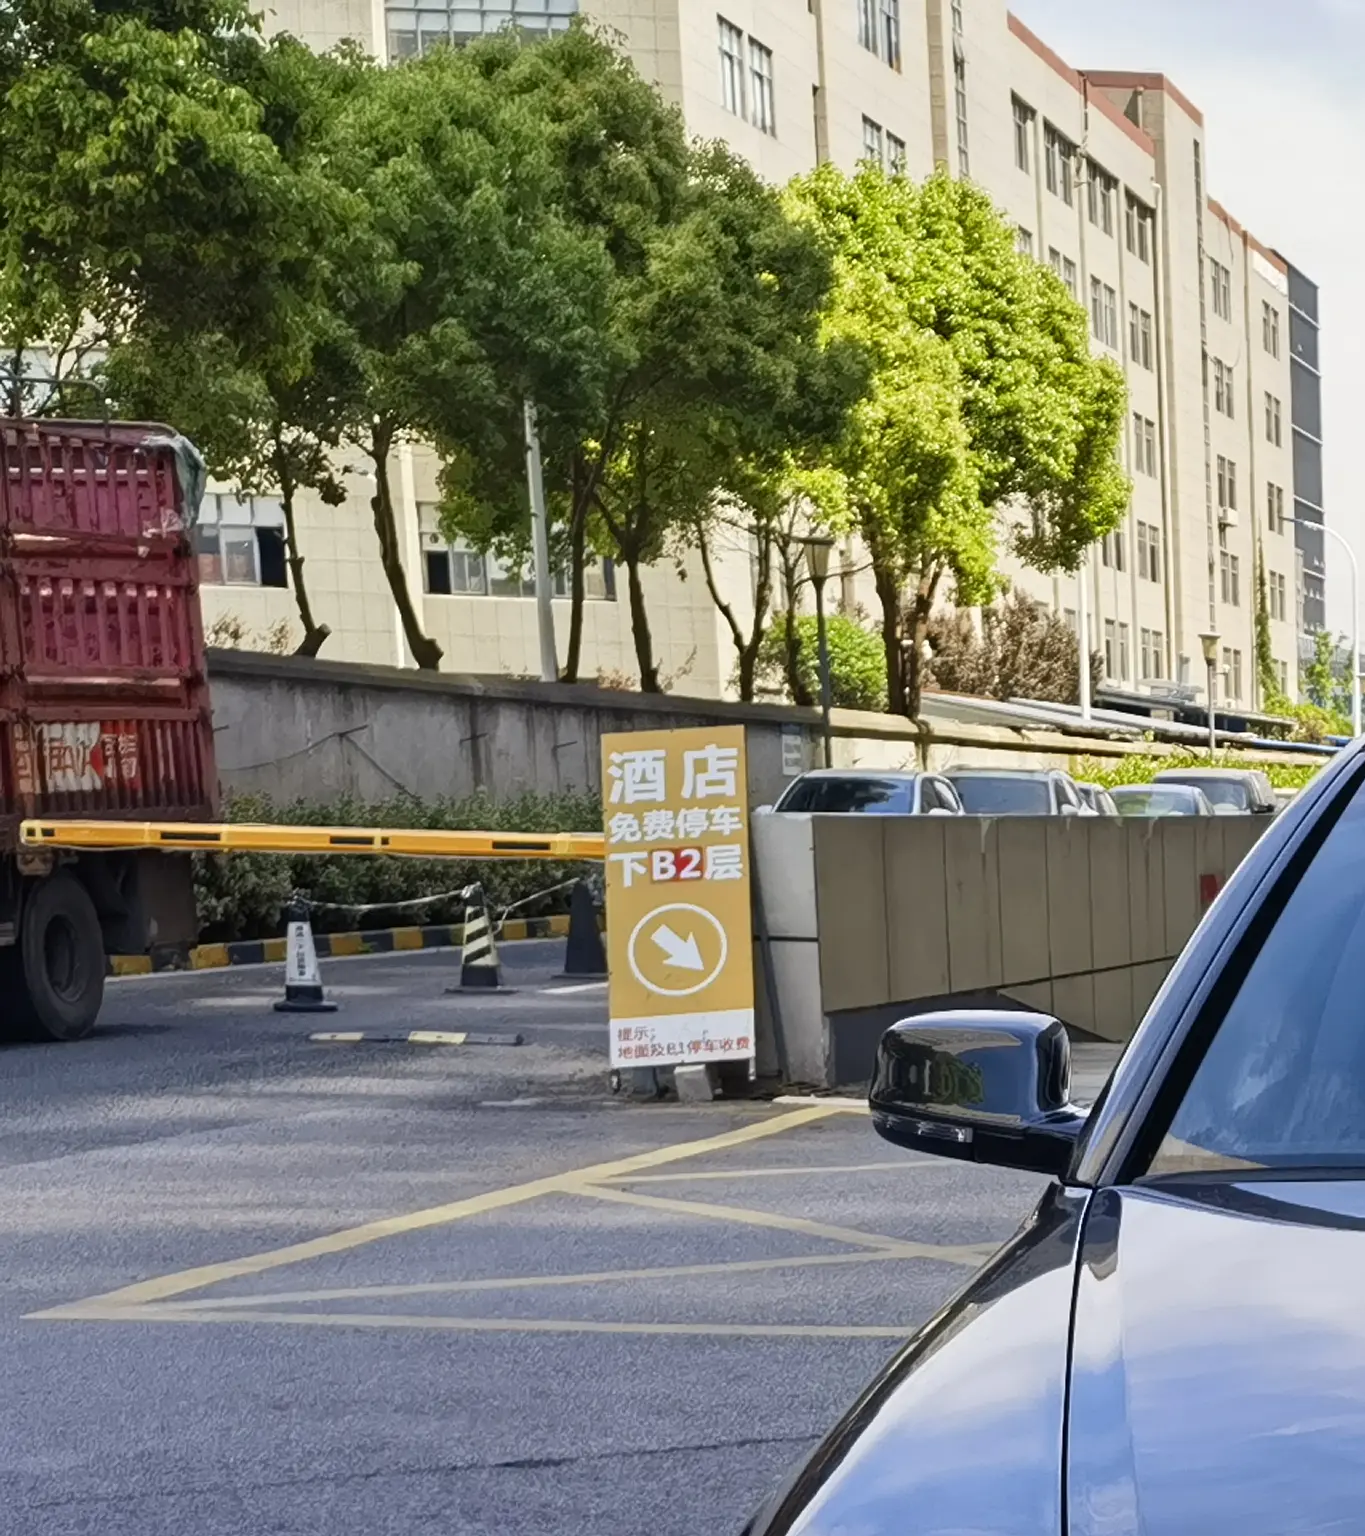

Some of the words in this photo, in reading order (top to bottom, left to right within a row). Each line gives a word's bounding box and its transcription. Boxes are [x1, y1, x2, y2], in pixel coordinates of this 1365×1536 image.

[607, 743, 738, 804] 酒店
[608, 804, 743, 844] 免费停车
[608, 843, 743, 888] 下B2层
